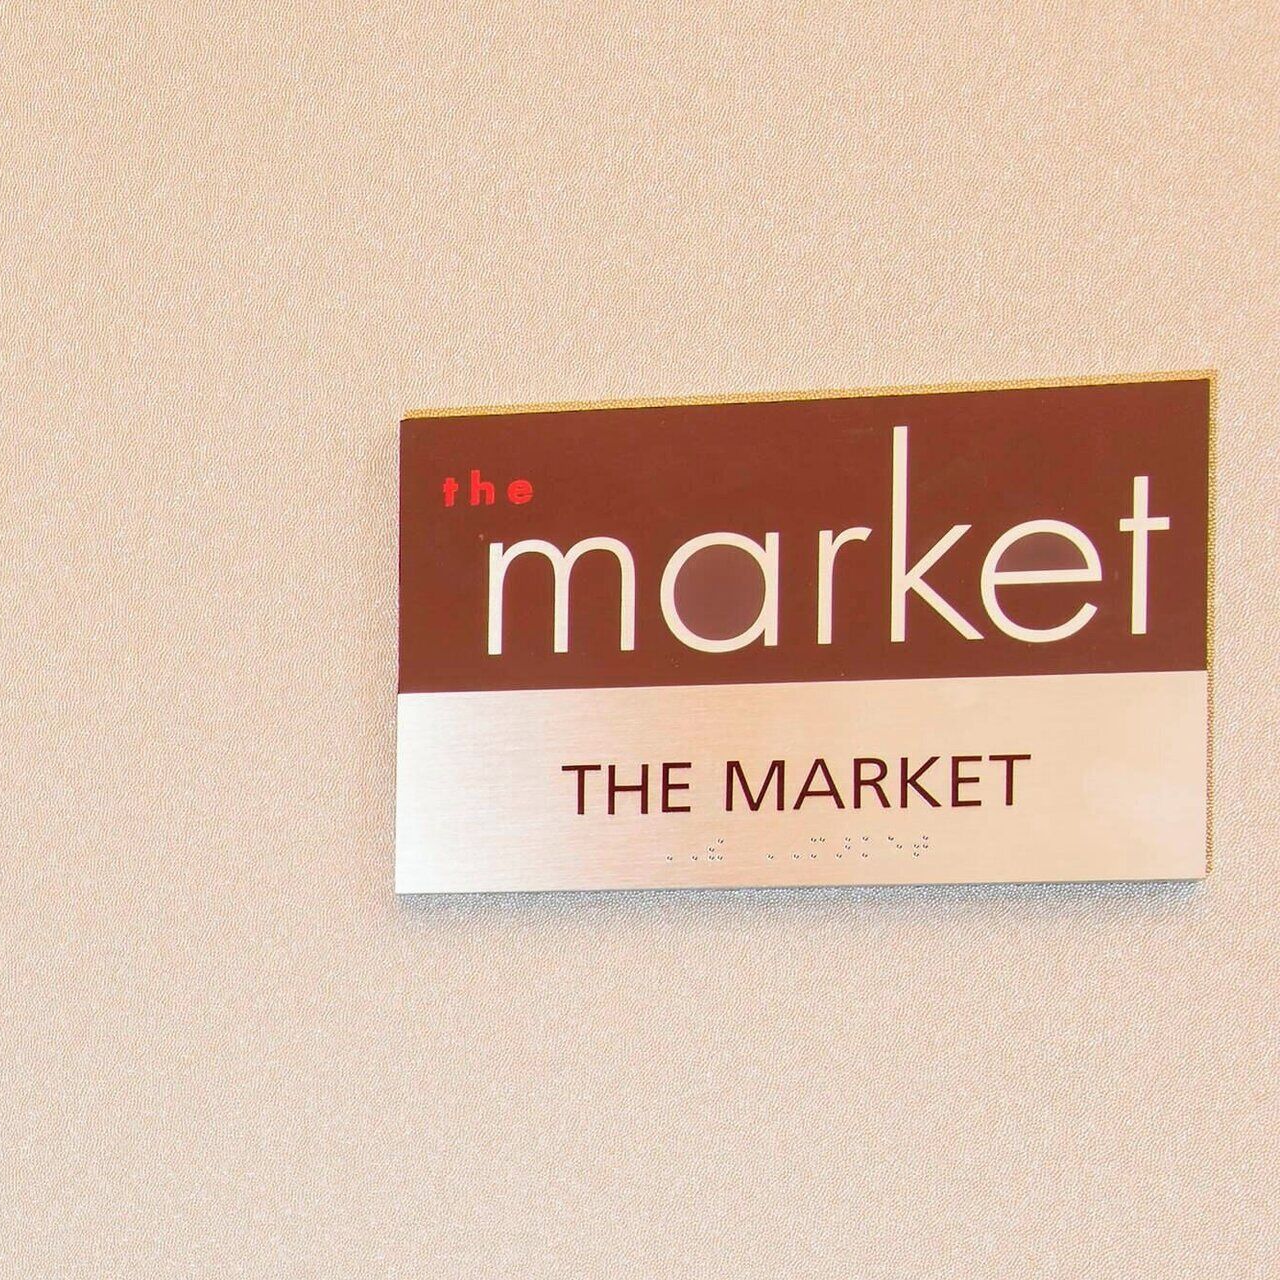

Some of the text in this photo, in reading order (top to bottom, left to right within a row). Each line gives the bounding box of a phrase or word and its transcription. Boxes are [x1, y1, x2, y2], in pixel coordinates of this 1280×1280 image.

[442, 470, 534, 508] the
[487, 425, 1171, 656] market
[561, 753, 1032, 817] THE MARKET
